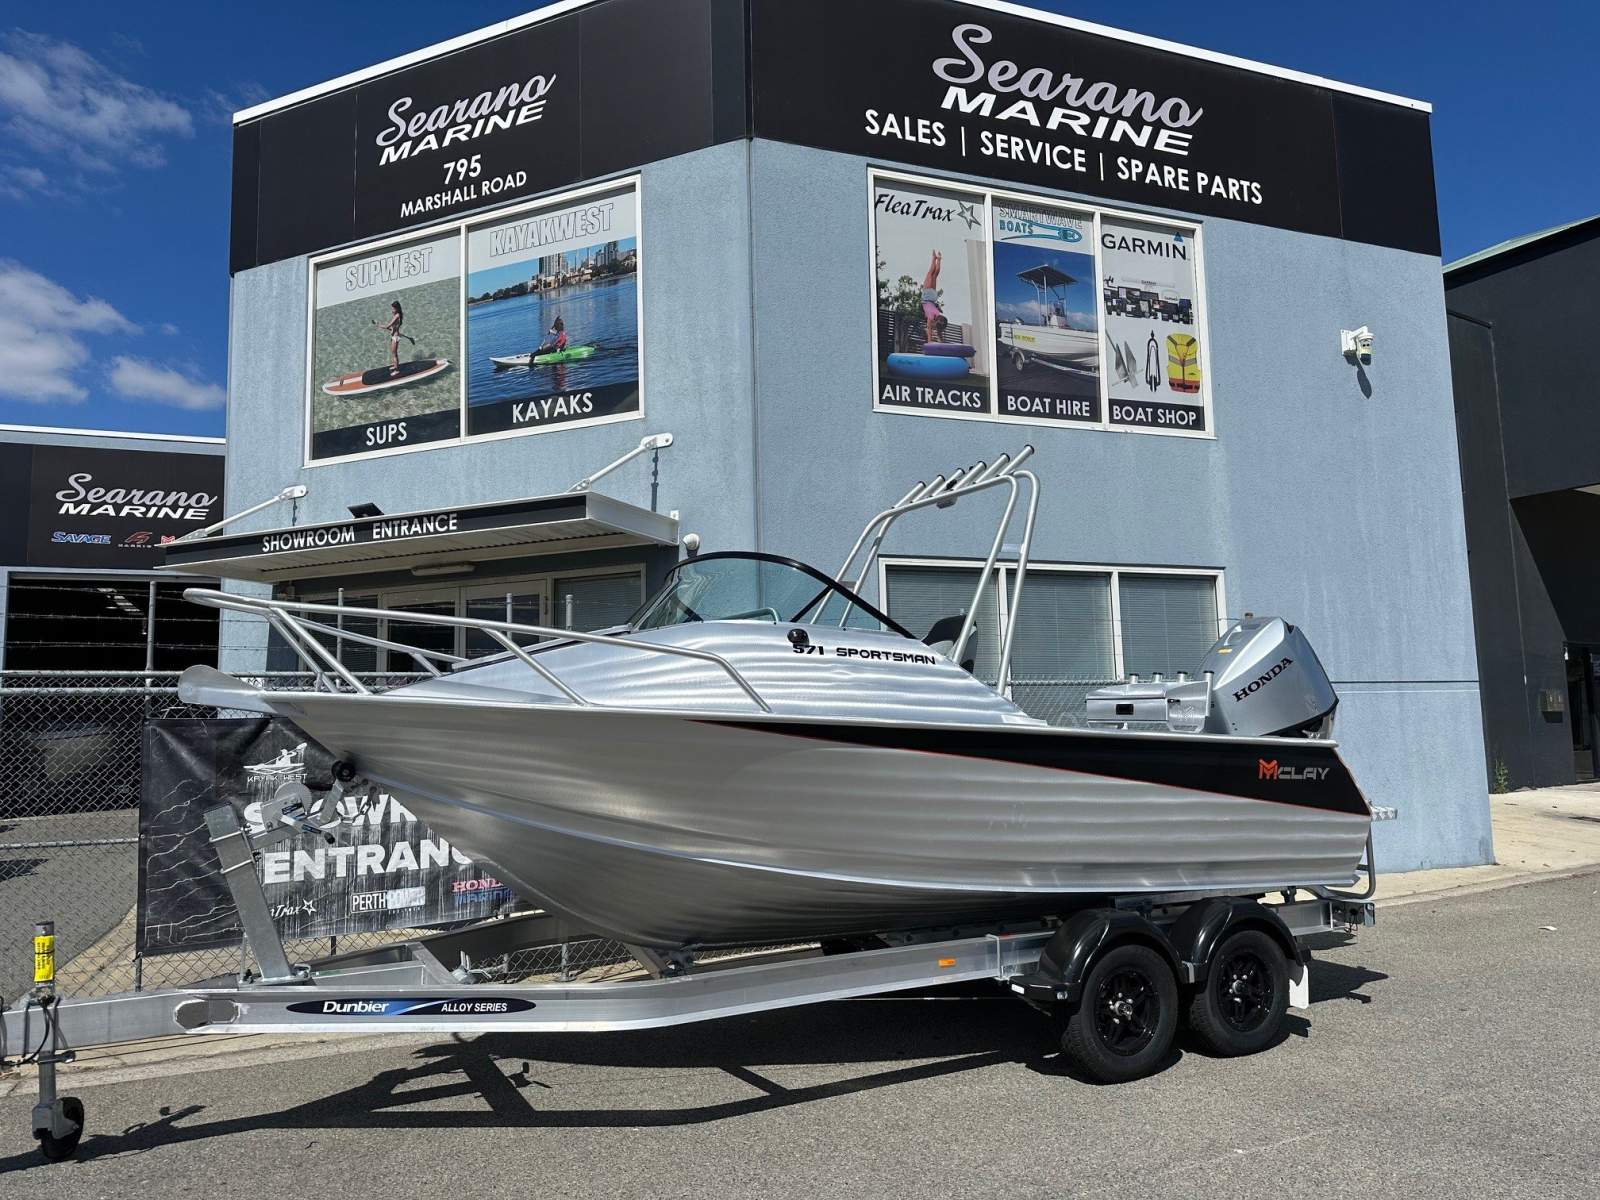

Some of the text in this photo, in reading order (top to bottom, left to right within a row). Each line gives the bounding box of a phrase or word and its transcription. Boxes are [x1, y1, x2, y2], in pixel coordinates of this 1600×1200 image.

[932, 23, 1204, 129] Searano
[375, 73, 557, 147] Searano
[940, 86, 1193, 156] MARINE
[379, 100, 547, 167] MARINE
[443, 153, 482, 185] 795
[864, 109, 1263, 206] SALES SERVICE SPARE PARTS
[400, 170, 527, 218] MARSHALL ROAD
[875, 193, 956, 222] FleaTrax
[489, 203, 614, 258] KAYAKWEST
[999, 219, 1034, 235] BOATS
[1101, 233, 1187, 261] GARMIN
[345, 247, 433, 292] SUPWEST
[512, 392, 594, 424] KAYAKS
[881, 384, 982, 408] AIR TRACKS
[1007, 395, 1090, 417] BOAT HIRE
[1112, 405, 1197, 426] BOAT SHOP
[366, 422, 408, 446] SUPS
[55, 472, 218, 508] Searano
[58, 503, 210, 521] MARINE
[51, 531, 113, 545] SAVAGE
[262, 513, 458, 552] SHOWROOM ENTRANCE
[793, 643, 937, 665] 571 SPORTSMAN
[1232, 656, 1294, 702] HONDA
[284, 773, 308, 781] WEST
[352, 893, 386, 912] PERTH
[322, 1000, 508, 1014] Dunbier ALLOY SERIES
